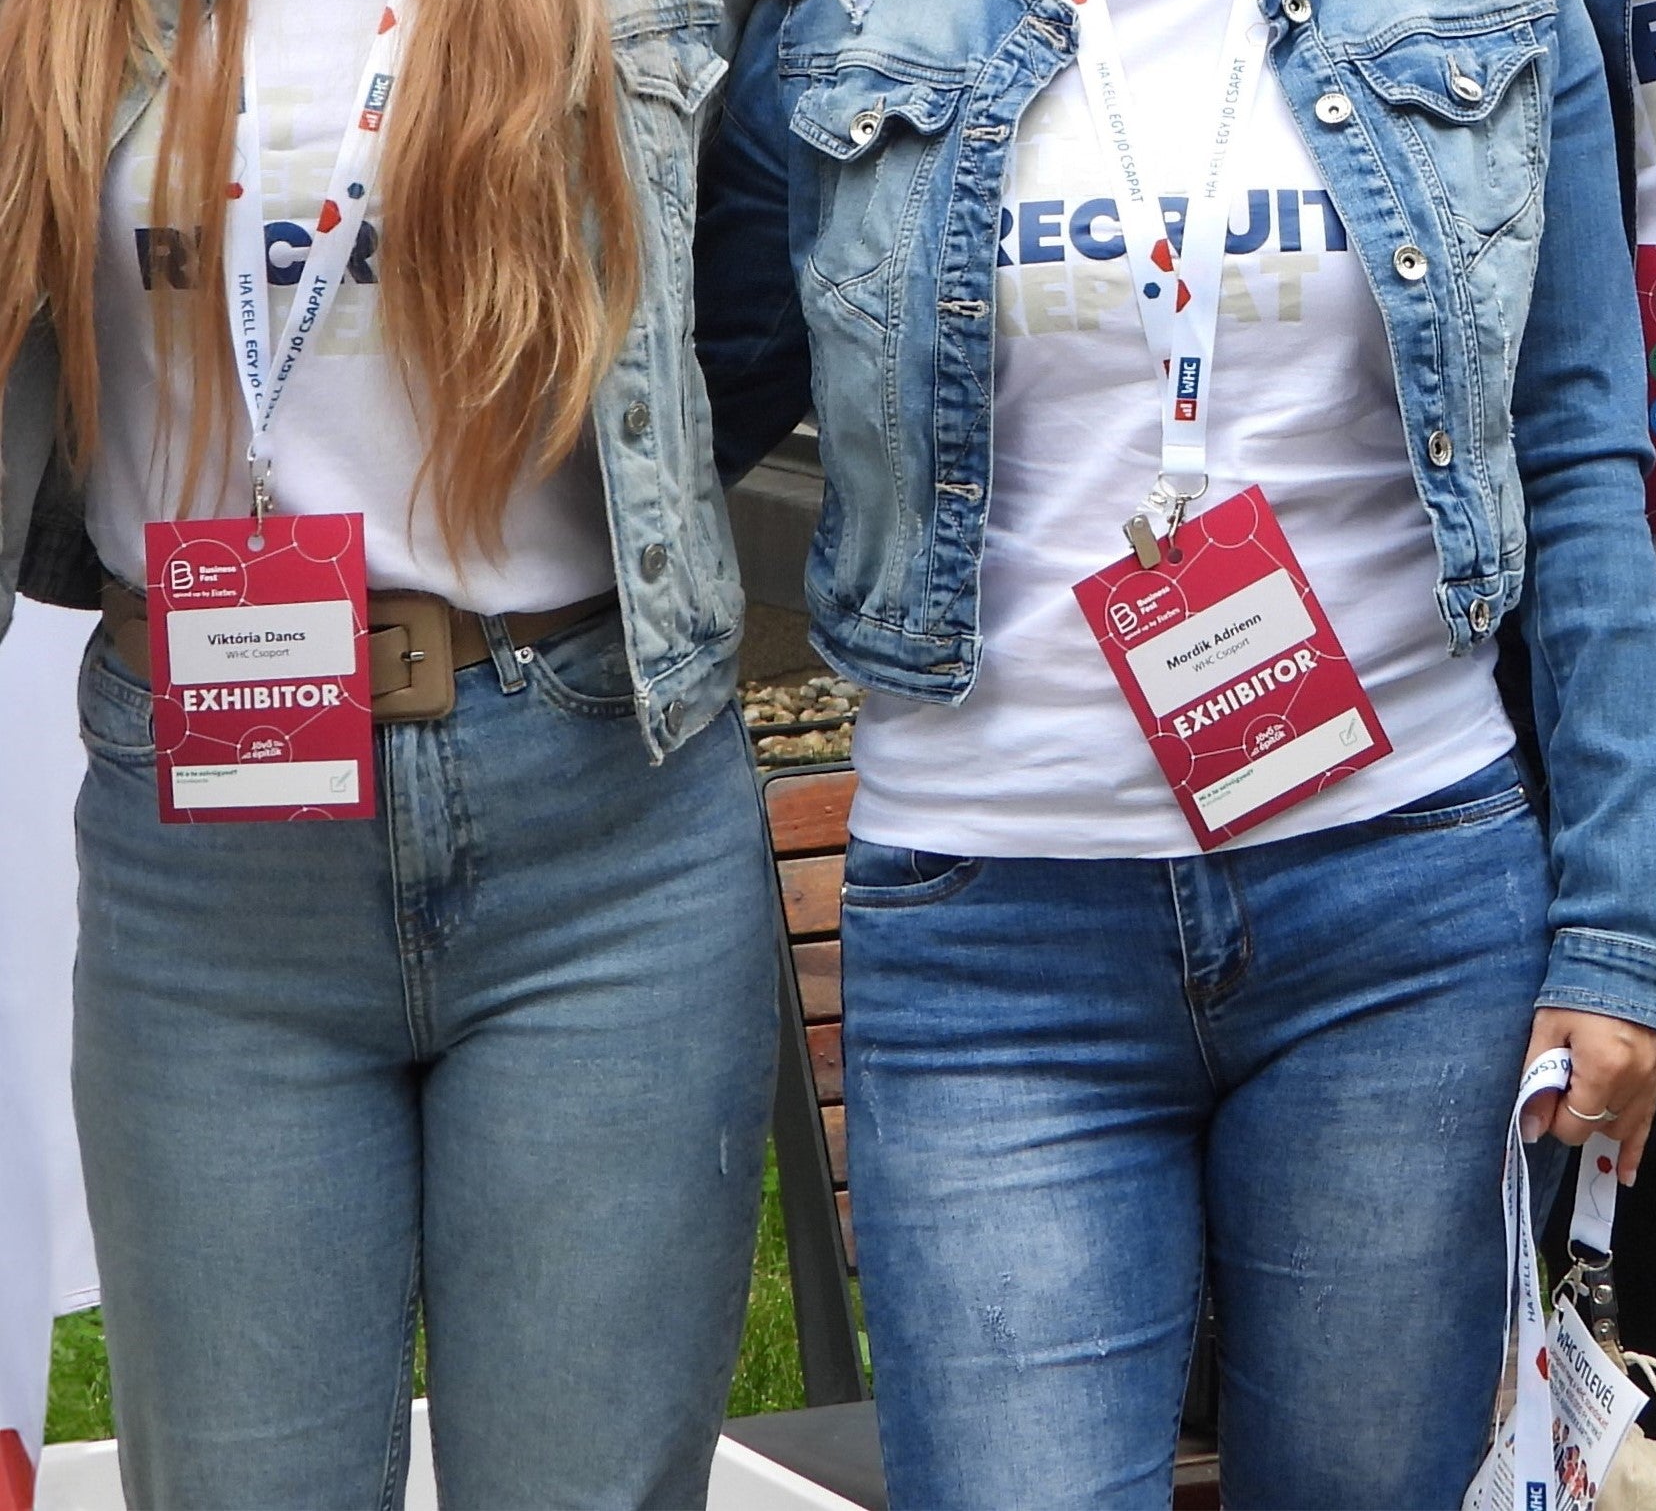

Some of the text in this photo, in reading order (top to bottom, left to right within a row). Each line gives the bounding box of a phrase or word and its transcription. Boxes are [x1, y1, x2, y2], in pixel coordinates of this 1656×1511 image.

[1097, 62, 1110, 79] HA
[368, 76, 391, 107] WHC
[1102, 82, 1116, 111] KELL
[1109, 113, 1126, 135] EGY
[1204, 180, 1216, 198] HA
[1216, 123, 1231, 145] EGY
[1226, 58, 1246, 104] CSAPAT
[1120, 155, 1144, 203] CSAPAT
[239, 274, 252, 296] HA
[997, 253, 1320, 337] EPAT
[240, 299, 256, 336] KELL
[278, 354, 296, 381] EGY
[291, 336, 304, 352] JÓ
[299, 275, 328, 333] CSAPAT
[246, 340, 258, 369] EGY
[248, 373, 262, 389] JÓ
[1180, 361, 1197, 396] WHC
[207, 630, 306, 646] Viktória Dancs
[226, 648, 290, 660] WHC Csoport
[1167, 612, 1262, 670] Mordik Adrienn
[1192, 638, 1251, 673] WHC Csoport
[183, 684, 341, 712] EXHIBITOR
[1172, 649, 1318, 739] EXHIBITOR
[1525, 1262, 1533, 1297] KELL
[1526, 1301, 1535, 1323] HA
[1556, 1326, 1577, 1363] WHC
[1575, 1350, 1615, 1415] ÚTLEVÉL
